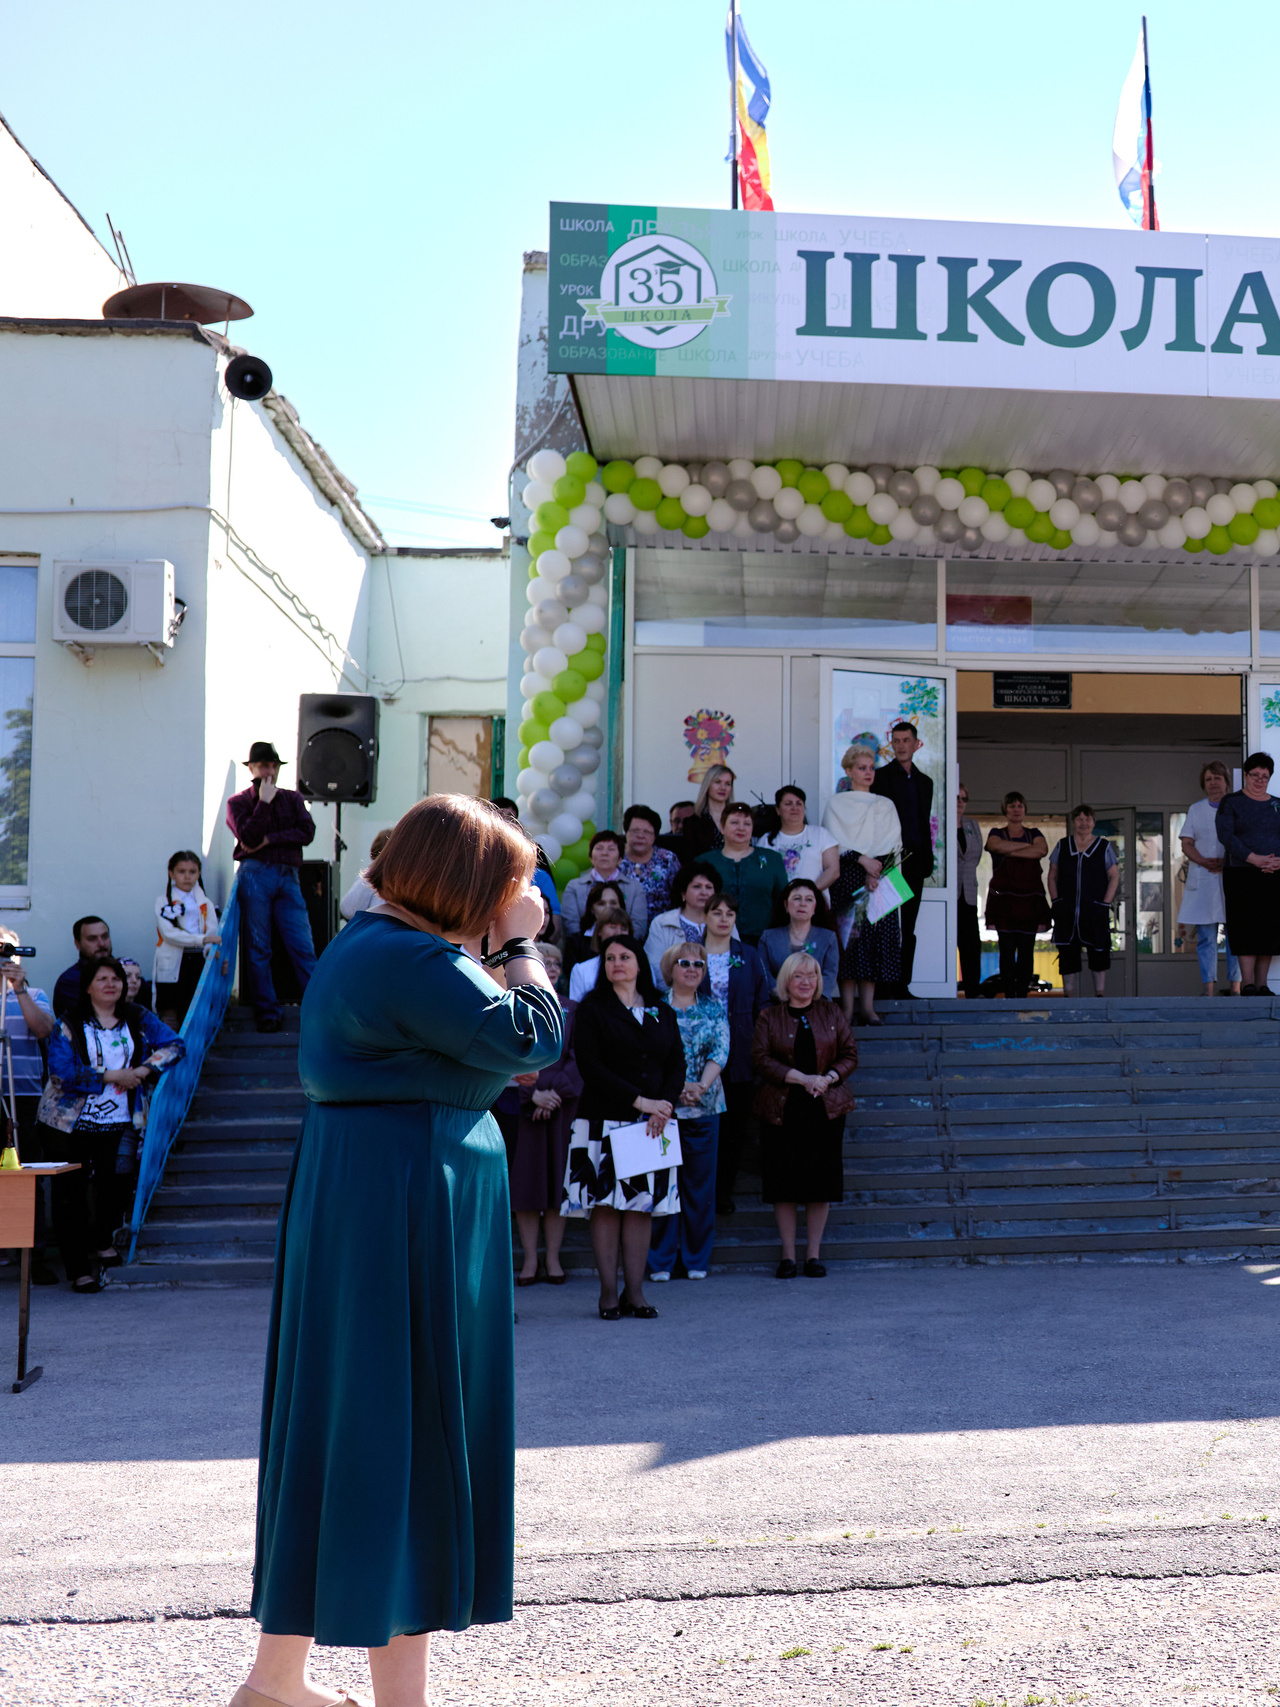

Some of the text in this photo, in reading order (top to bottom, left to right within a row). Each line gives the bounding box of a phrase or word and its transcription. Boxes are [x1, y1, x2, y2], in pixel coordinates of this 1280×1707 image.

[559, 218, 615, 233] ШКОЛА
[774, 230, 828, 243] ШКОЛА
[838, 229, 908, 249] УЧЕБА
[722, 259, 782, 274] ШКОЛА
[559, 283, 595, 297] УРОК
[628, 267, 683, 305] 35
[623, 309, 693, 322] ШКОЛА
[678, 349, 738, 363] ШКОЛА
[795, 350, 865, 368] УЧЕБА
[1004, 695, 1038, 703] ШКОЛА
